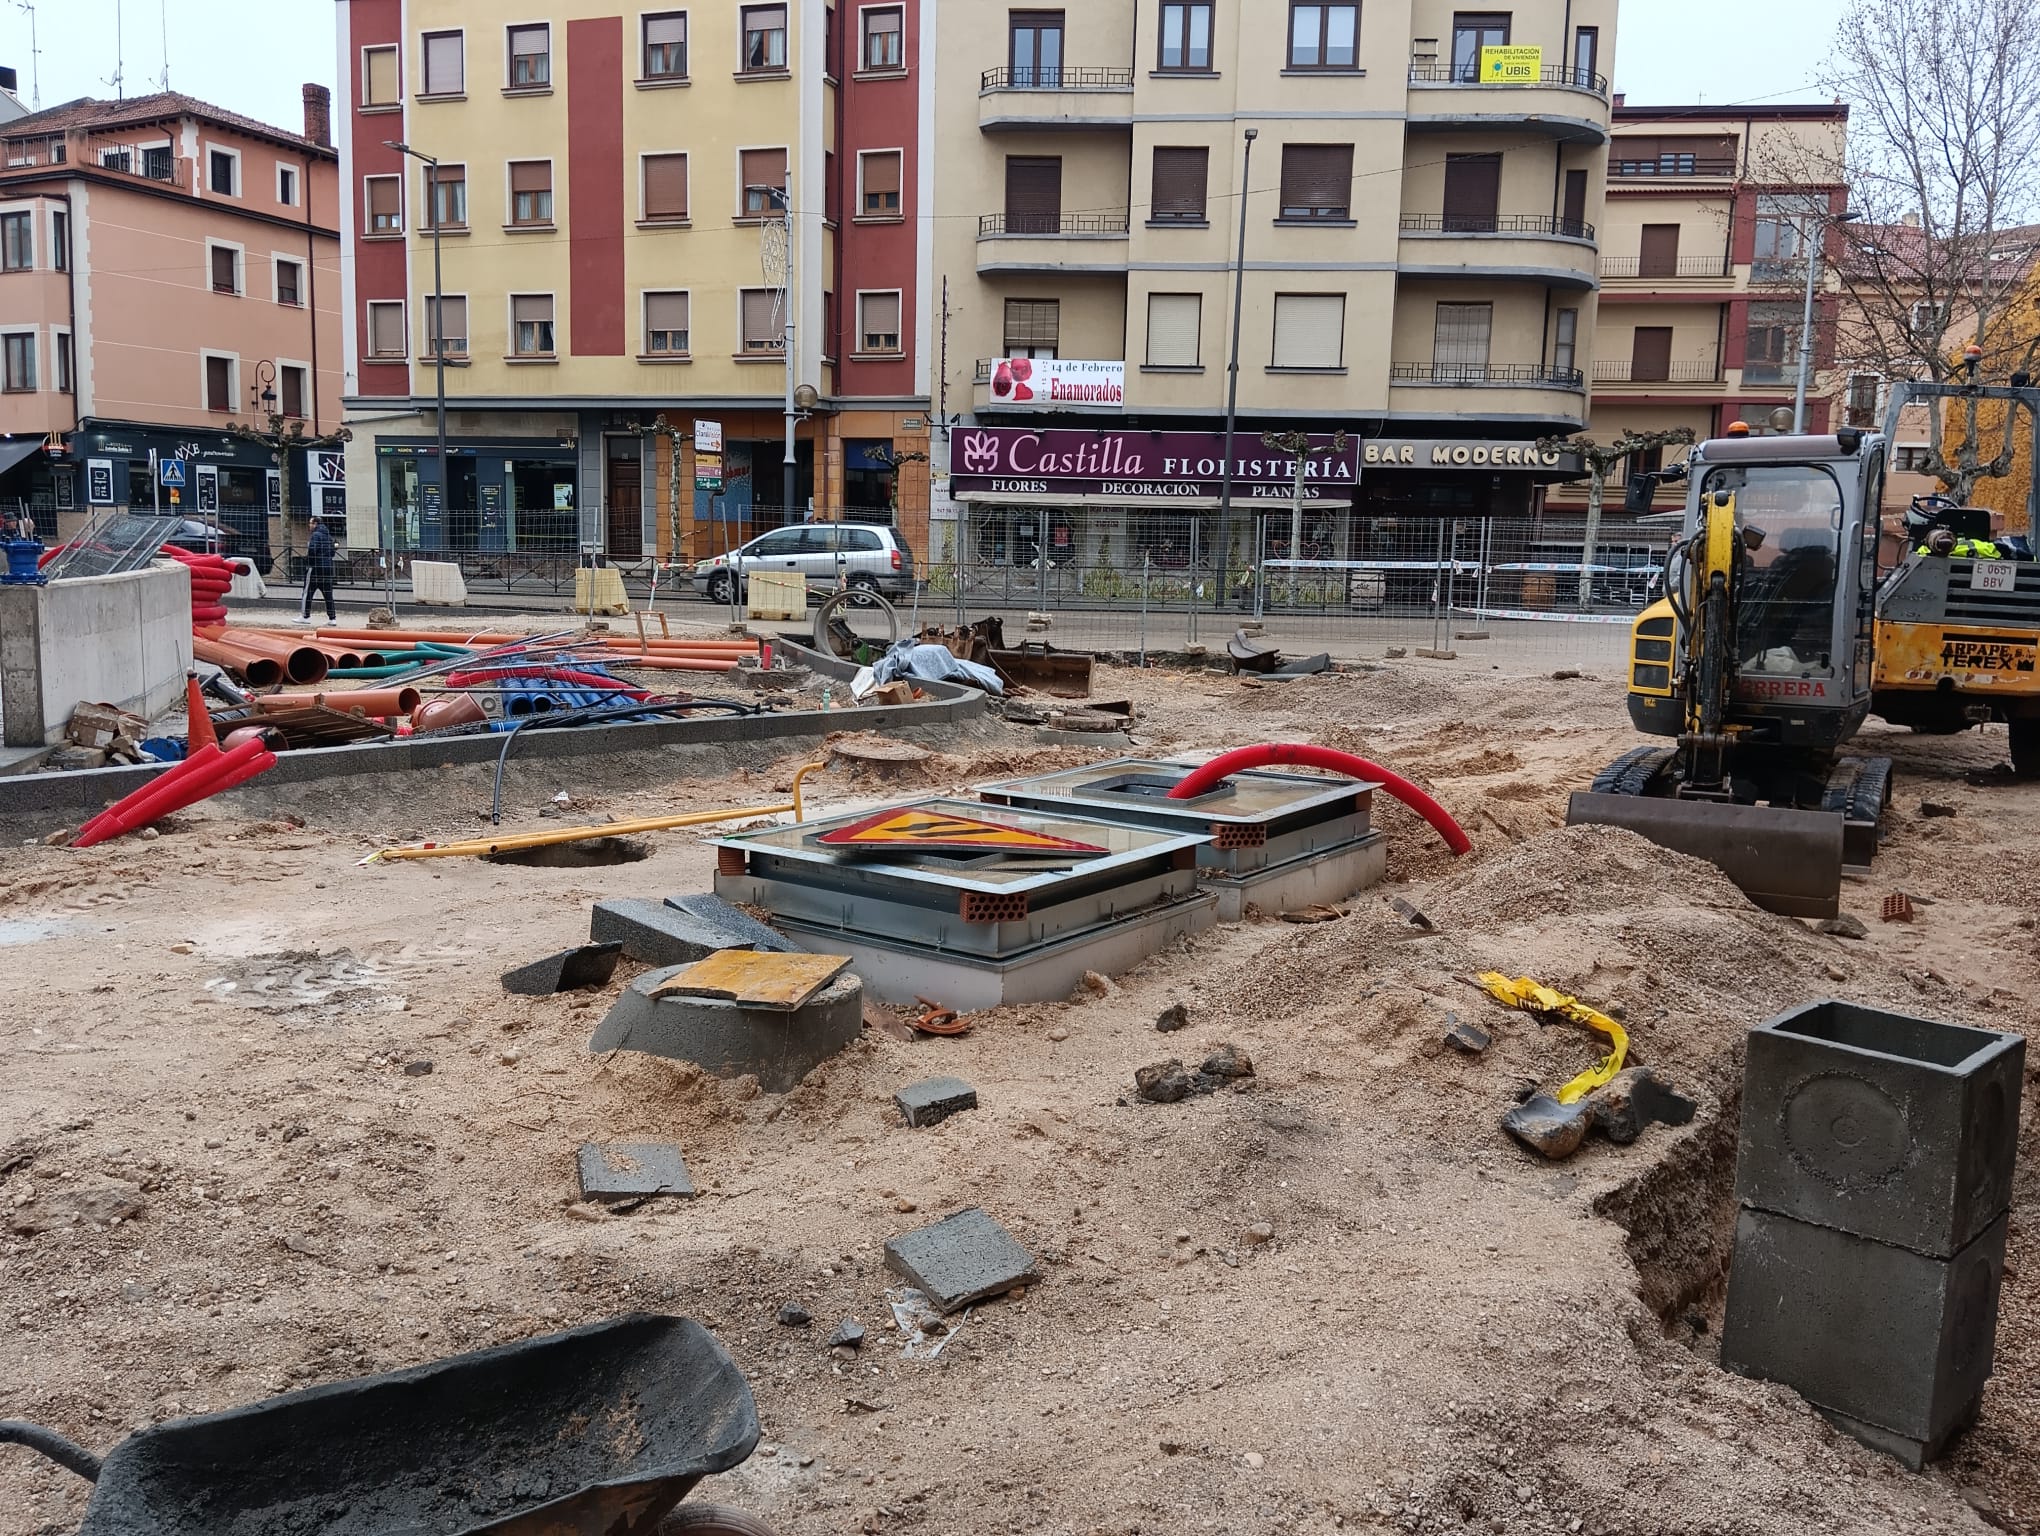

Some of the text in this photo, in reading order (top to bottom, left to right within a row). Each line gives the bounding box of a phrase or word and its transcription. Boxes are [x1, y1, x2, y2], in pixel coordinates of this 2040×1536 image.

[1506, 66, 1531, 75] UBIS
[1052, 362, 1123, 373] 14 de Febrero
[1050, 377, 1122, 402] Enamorados
[1009, 434, 1145, 475] Castilla
[1364, 445, 1560, 465] BAR MODERNO
[318, 453, 345, 482] NX
[991, 479, 1047, 493] FLORES
[1102, 482, 1200, 496] DECORACIÓN
[1252, 485, 1320, 499] PLANAS
[1977, 563, 1984, 574] E
[1983, 576, 2004, 588] BBV
[1940, 654, 2012, 670] TEREX
